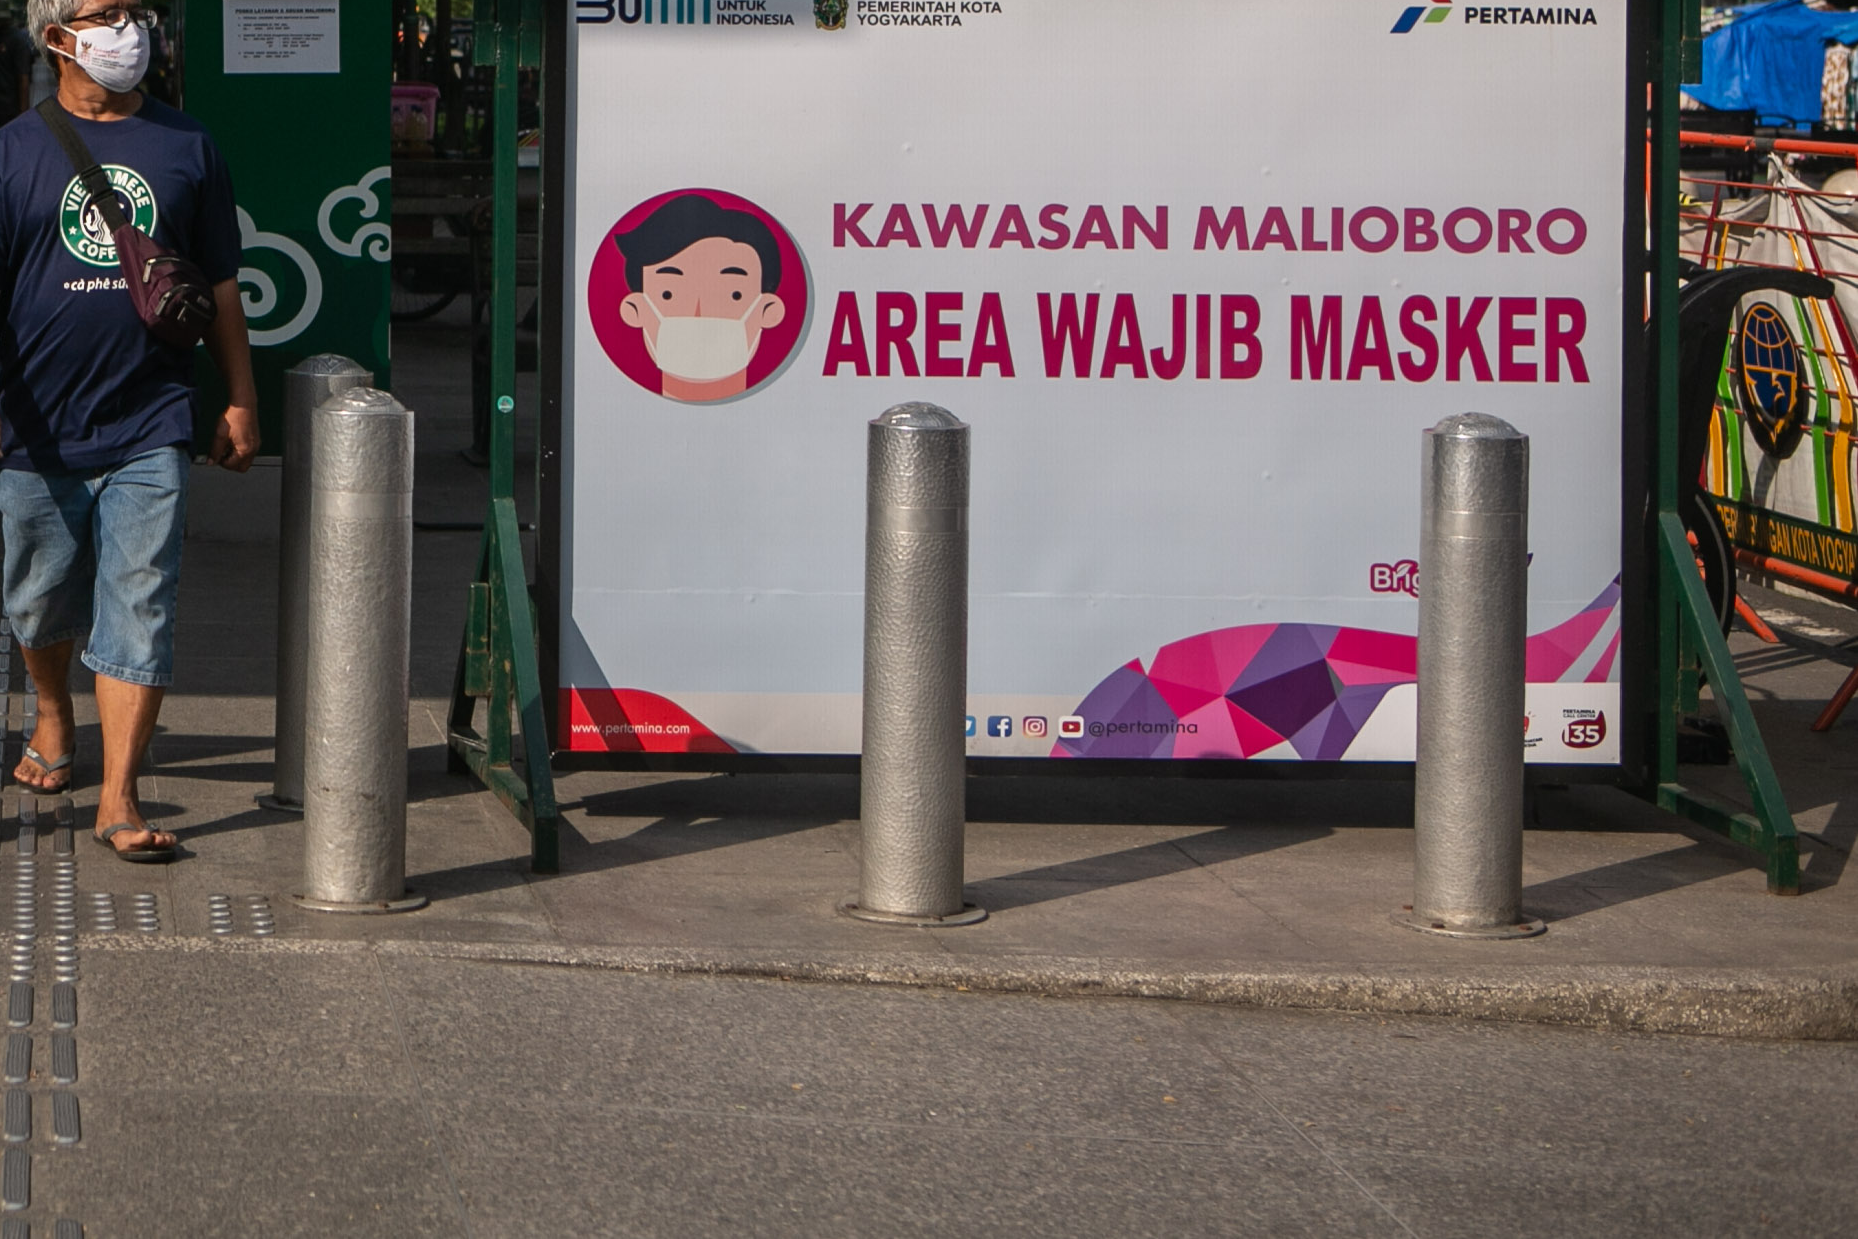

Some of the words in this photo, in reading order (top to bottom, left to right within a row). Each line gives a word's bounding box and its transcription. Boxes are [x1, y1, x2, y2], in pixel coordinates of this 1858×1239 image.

[717, 0, 766, 12] UNTUK
[857, 1, 956, 14] PEMERINTAH
[960, 1, 1002, 14] KOTA
[716, 13, 795, 26] INDONESIA
[857, 14, 962, 27] YOGYAKARTA
[1465, 6, 1597, 25] PERTAMINA
[833, 203, 1169, 250] KAWASAN
[1193, 205, 1588, 256] MALIOBORO
[77, 238, 117, 260] COFF
[85, 276, 110, 294] phê
[822, 291, 1016, 378] AREA
[1037, 292, 1263, 381] WAJIB
[1290, 295, 1591, 384] MASKER
[1791, 526, 1820, 566] KOTA
[1817, 533, 1858, 576] YOGYA
[571, 722, 690, 736] www.pertamina.com
[1088, 719, 1198, 737] @pertamina
[1564, 725, 1600, 743] 135
